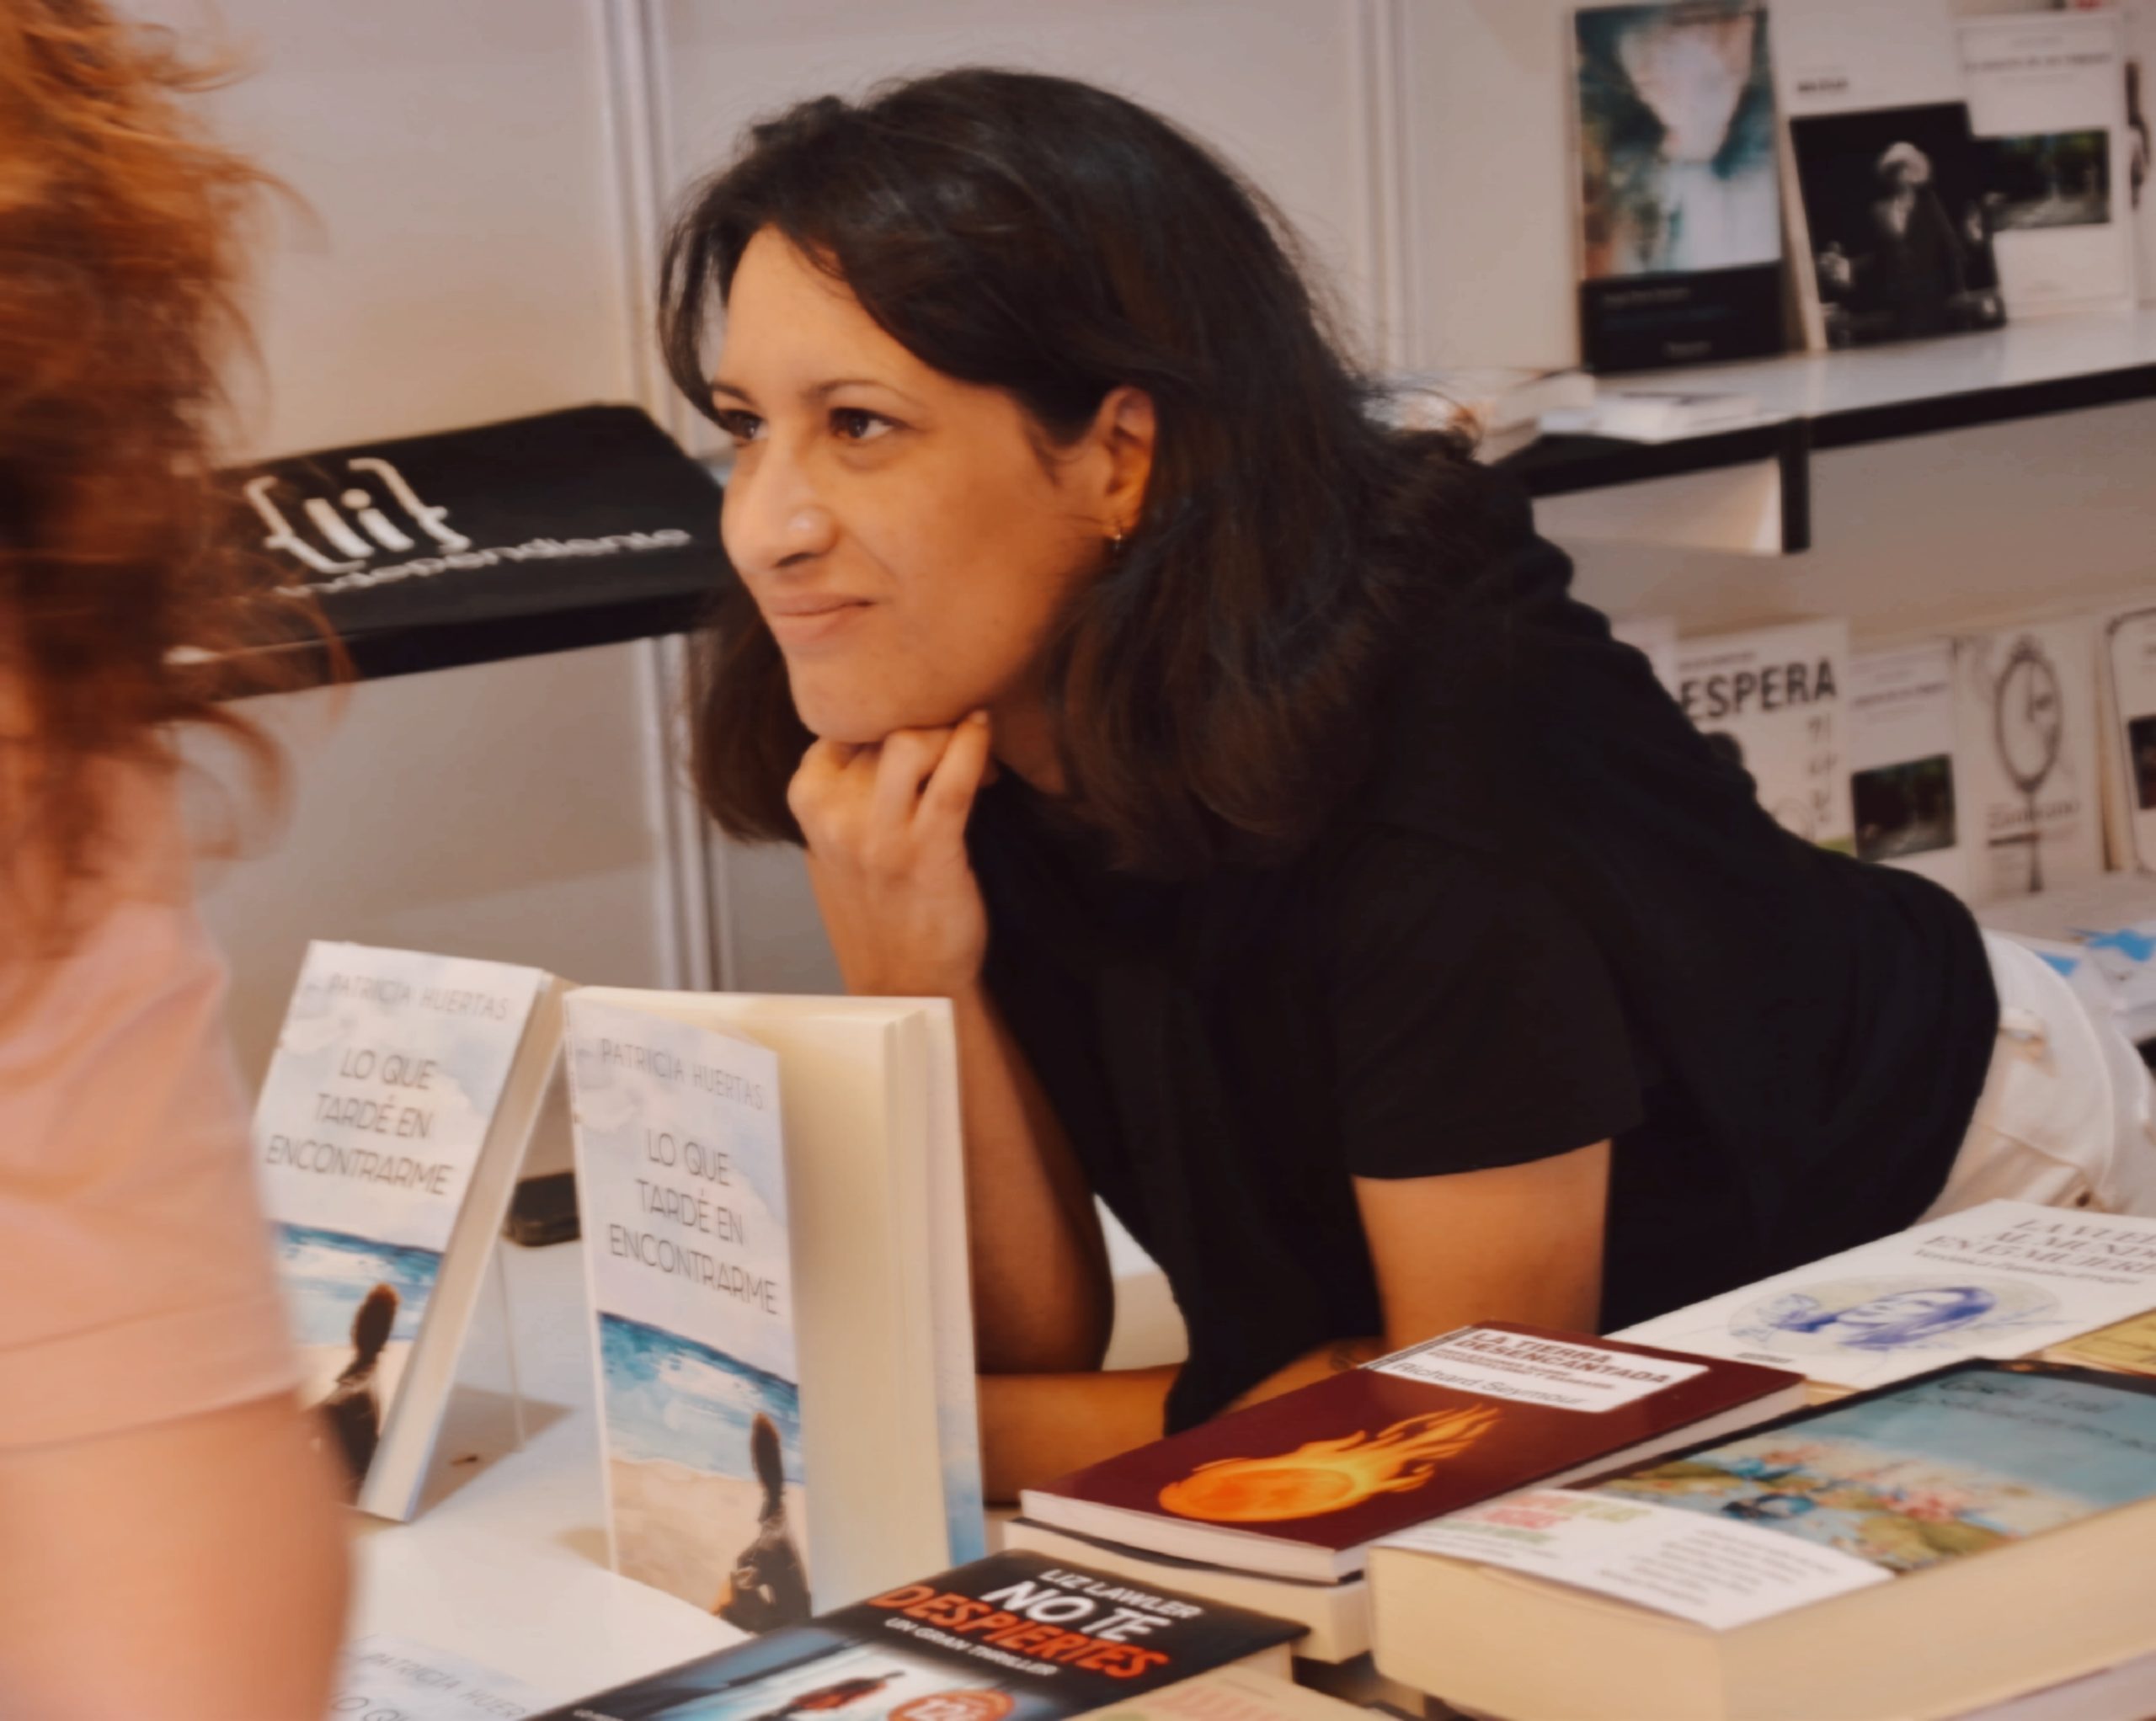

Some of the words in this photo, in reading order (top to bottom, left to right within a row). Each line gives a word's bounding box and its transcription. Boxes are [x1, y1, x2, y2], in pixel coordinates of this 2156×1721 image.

[329, 974, 411, 1004] PATRICIA
[420, 987, 510, 1021] HUERTAS
[339, 1047, 376, 1080] LO
[382, 1054, 437, 1090] QUE
[600, 1037, 684, 1082] PATRICIA
[692, 1063, 765, 1111] HUERTAS
[316, 1093, 395, 1134] TARDÉ
[395, 1106, 434, 1138] EN
[265, 1134, 454, 1196] ENCONTRARME
[647, 1128, 675, 1168] LO
[684, 1142, 731, 1186] QUE
[636, 1179, 710, 1233] TARDÉ
[717, 1206, 745, 1246] EN
[609, 1223, 779, 1315] ENCONTRARME
[1454, 1339, 1671, 1383] DESENCANTADA
[1472, 1331, 1508, 1345] LA
[1518, 1339, 1612, 1363] TIERRA
[1392, 1361, 1479, 1387] Richard
[1481, 1379, 1589, 1404] Seymour
[979, 1580, 1098, 1623] NO
[1080, 1606, 1173, 1643] TE
[1038, 1568, 1092, 1590] LIZ
[1091, 1580, 1204, 1619] LAWLER
[866, 1584, 1170, 1679] DESPIERTES
[884, 1617, 916, 1633] UN
[914, 1625, 972, 1652] GRAN
[966, 1644, 1060, 1677] THRILLER
[456, 1688, 527, 1718] HUER
